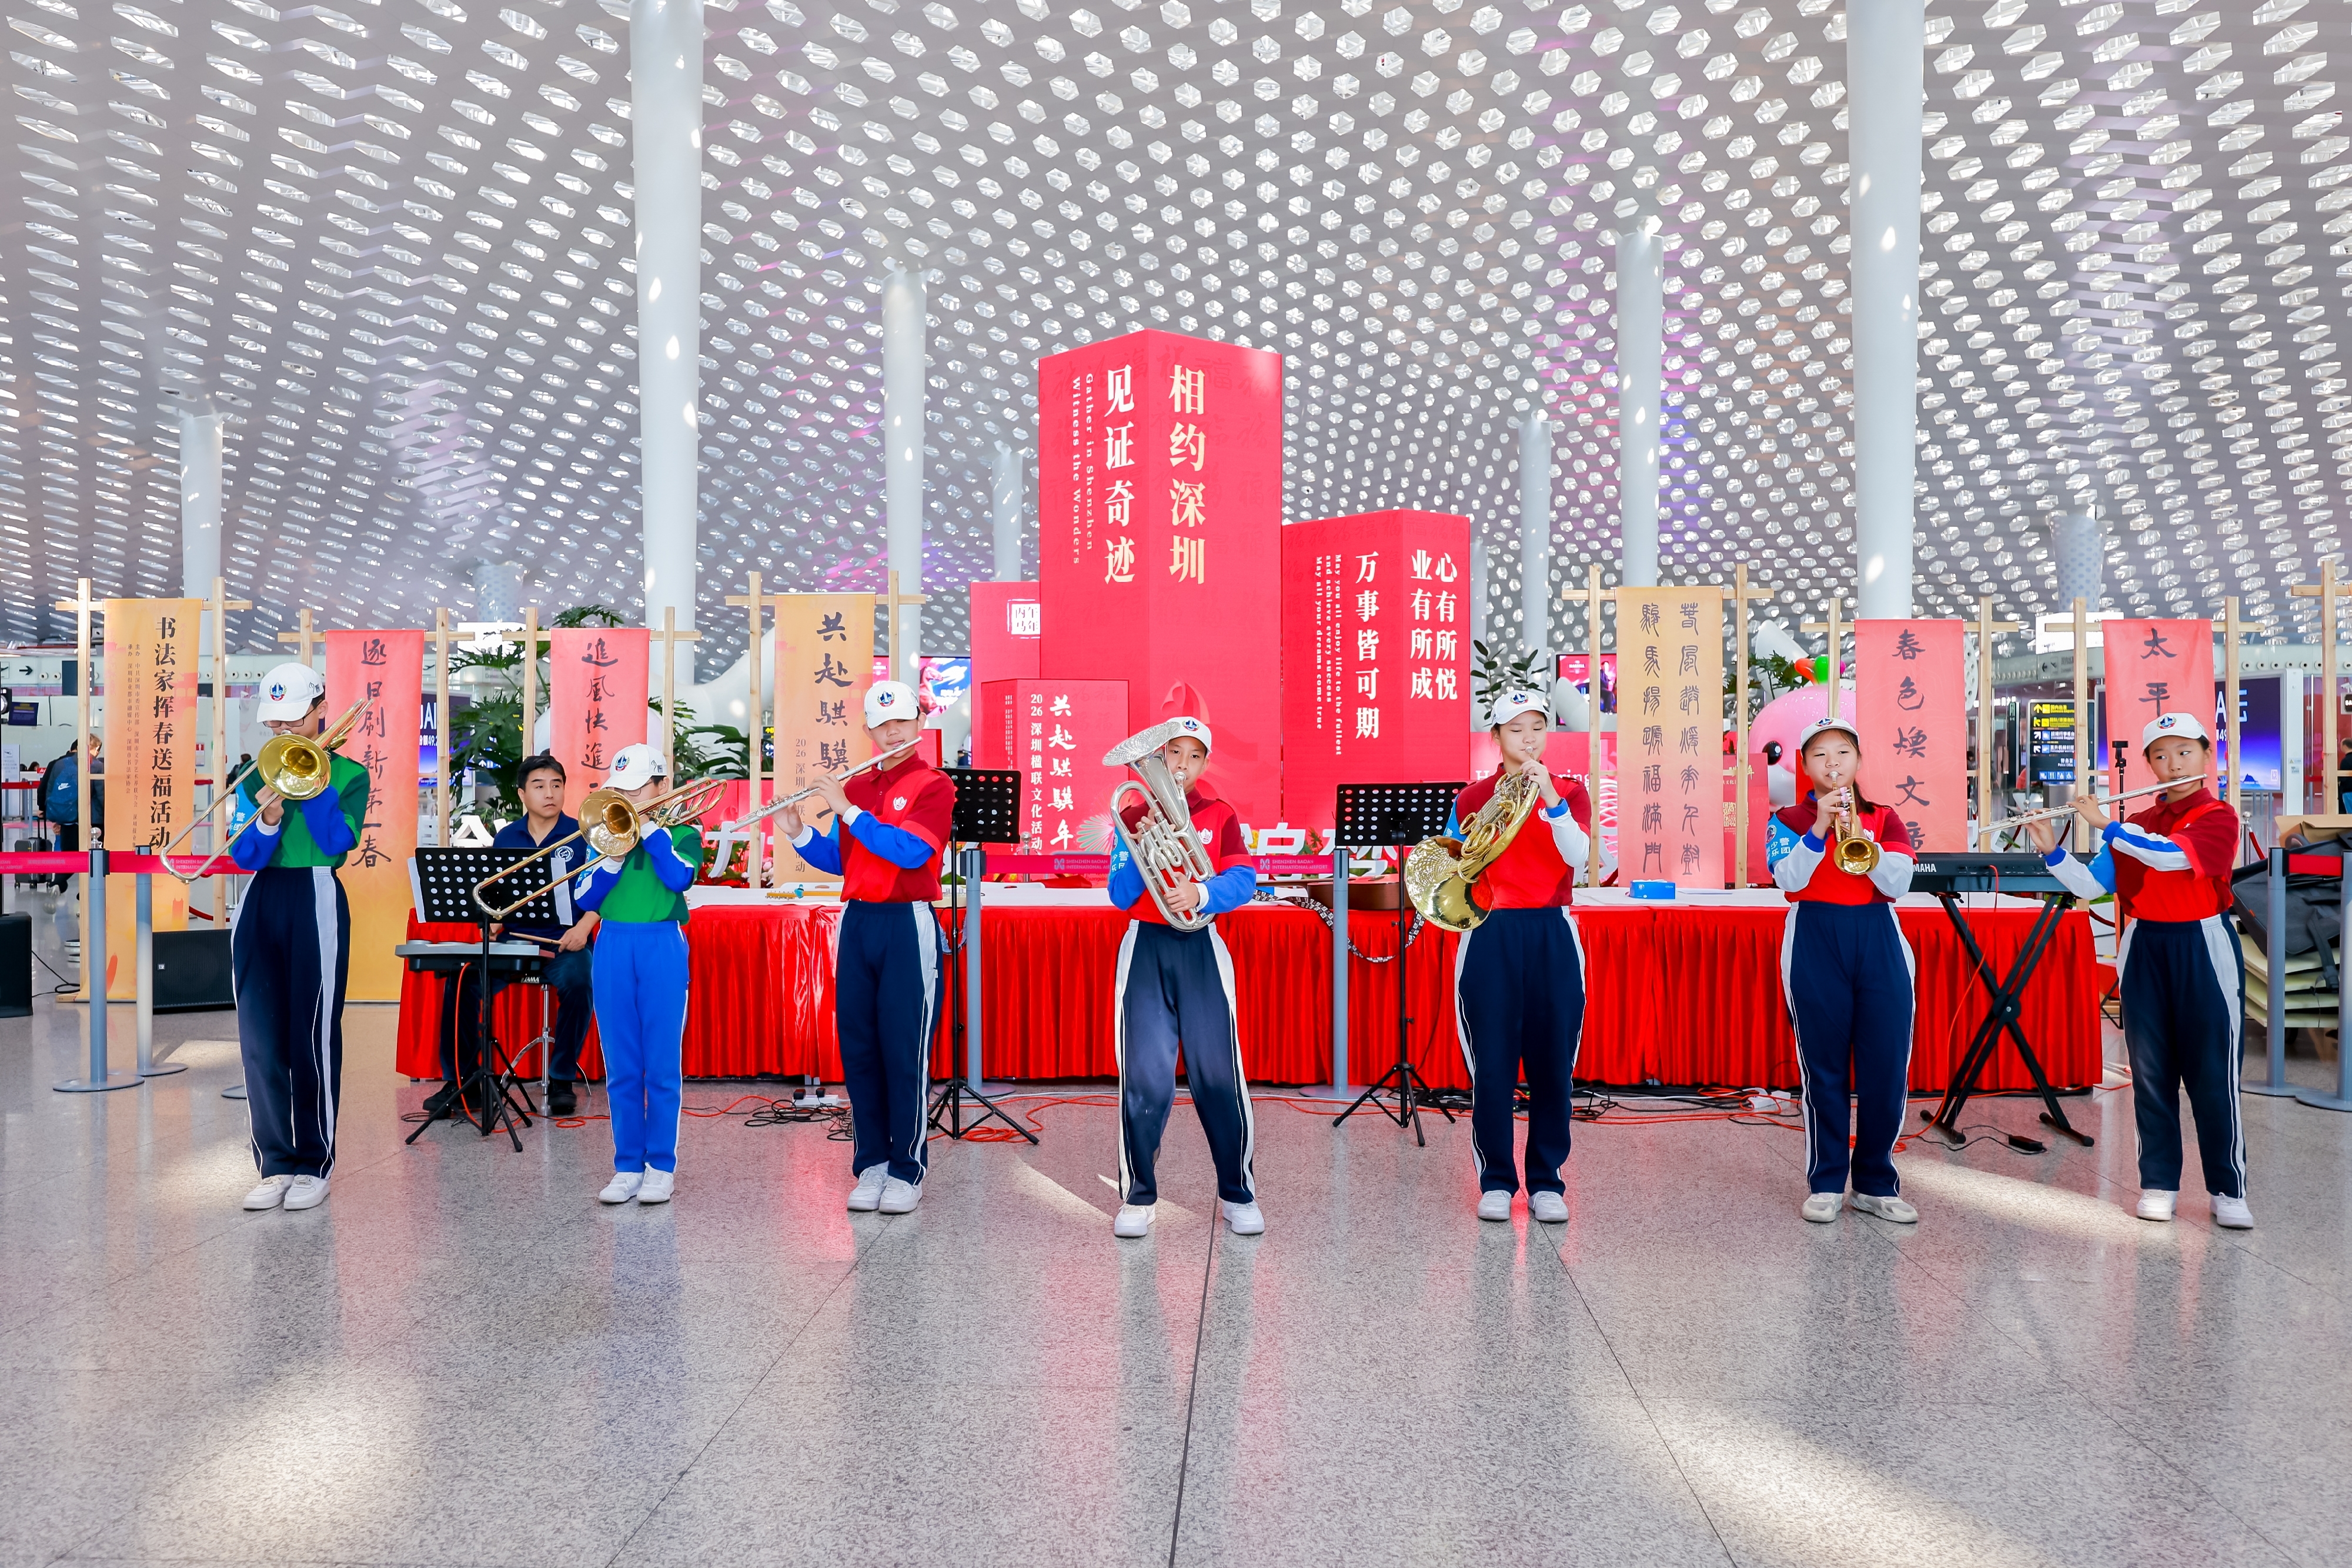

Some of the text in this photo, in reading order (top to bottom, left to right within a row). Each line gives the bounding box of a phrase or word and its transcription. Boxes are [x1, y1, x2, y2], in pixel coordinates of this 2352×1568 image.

[1072, 376, 1081, 564] Witness the Wonders
[1086, 440, 1094, 458] in
[1104, 364, 1135, 584] 见证奇迹
[1168, 364, 1206, 584] 相约深圳
[128, 644, 133, 657] 承办
[135, 644, 141, 657] 主办
[1335, 681, 1341, 692] to
[1355, 551, 1380, 739] 万事皆可期
[1411, 549, 1433, 700] 业有所成
[1435, 552, 1458, 700] 心有所悦
[149, 617, 176, 849] 书法家挥春送福活动
[1913, 864, 1937, 872] MAHA
